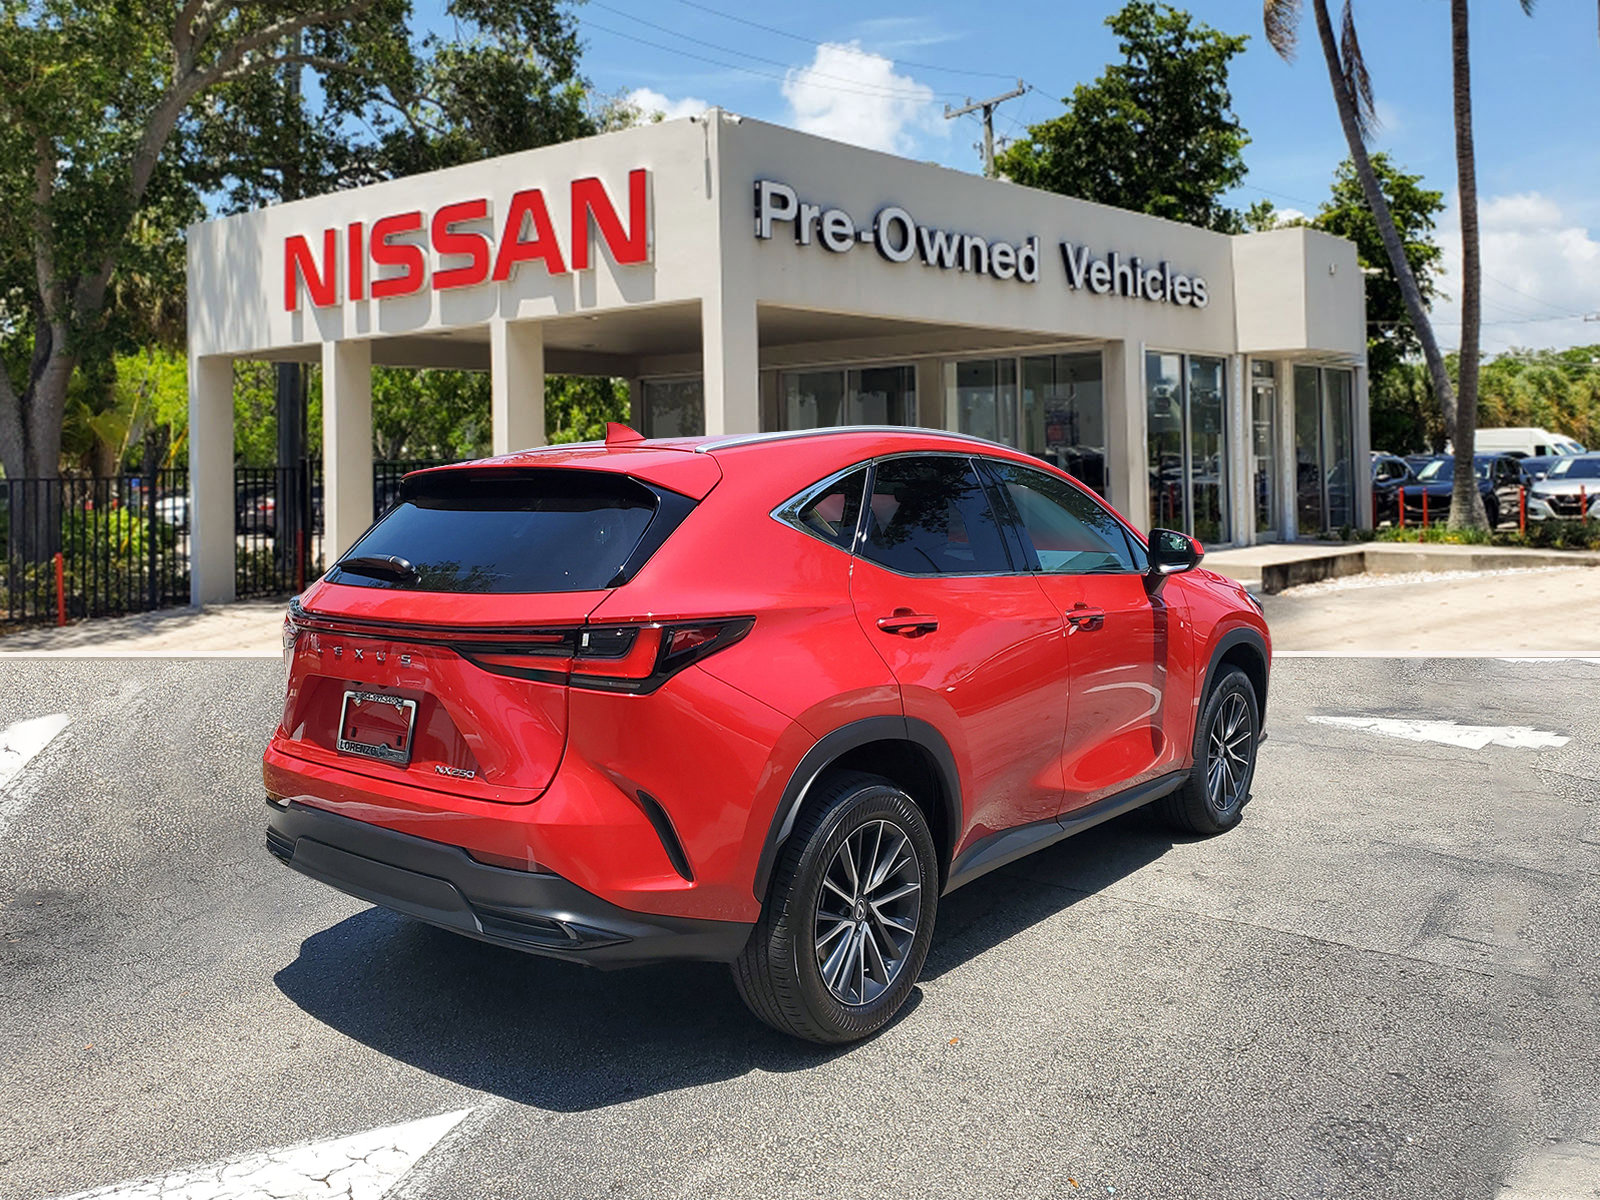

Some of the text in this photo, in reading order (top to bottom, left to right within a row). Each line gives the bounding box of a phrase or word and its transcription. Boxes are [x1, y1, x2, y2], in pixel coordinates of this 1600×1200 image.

[285, 168, 648, 312] NISSAN
[755, 179, 1209, 309] Pre-Owned Vehicles
[316, 643, 412, 665] LEXUS
[339, 740, 378, 757] LORENZO
[434, 765, 476, 779] NX250
